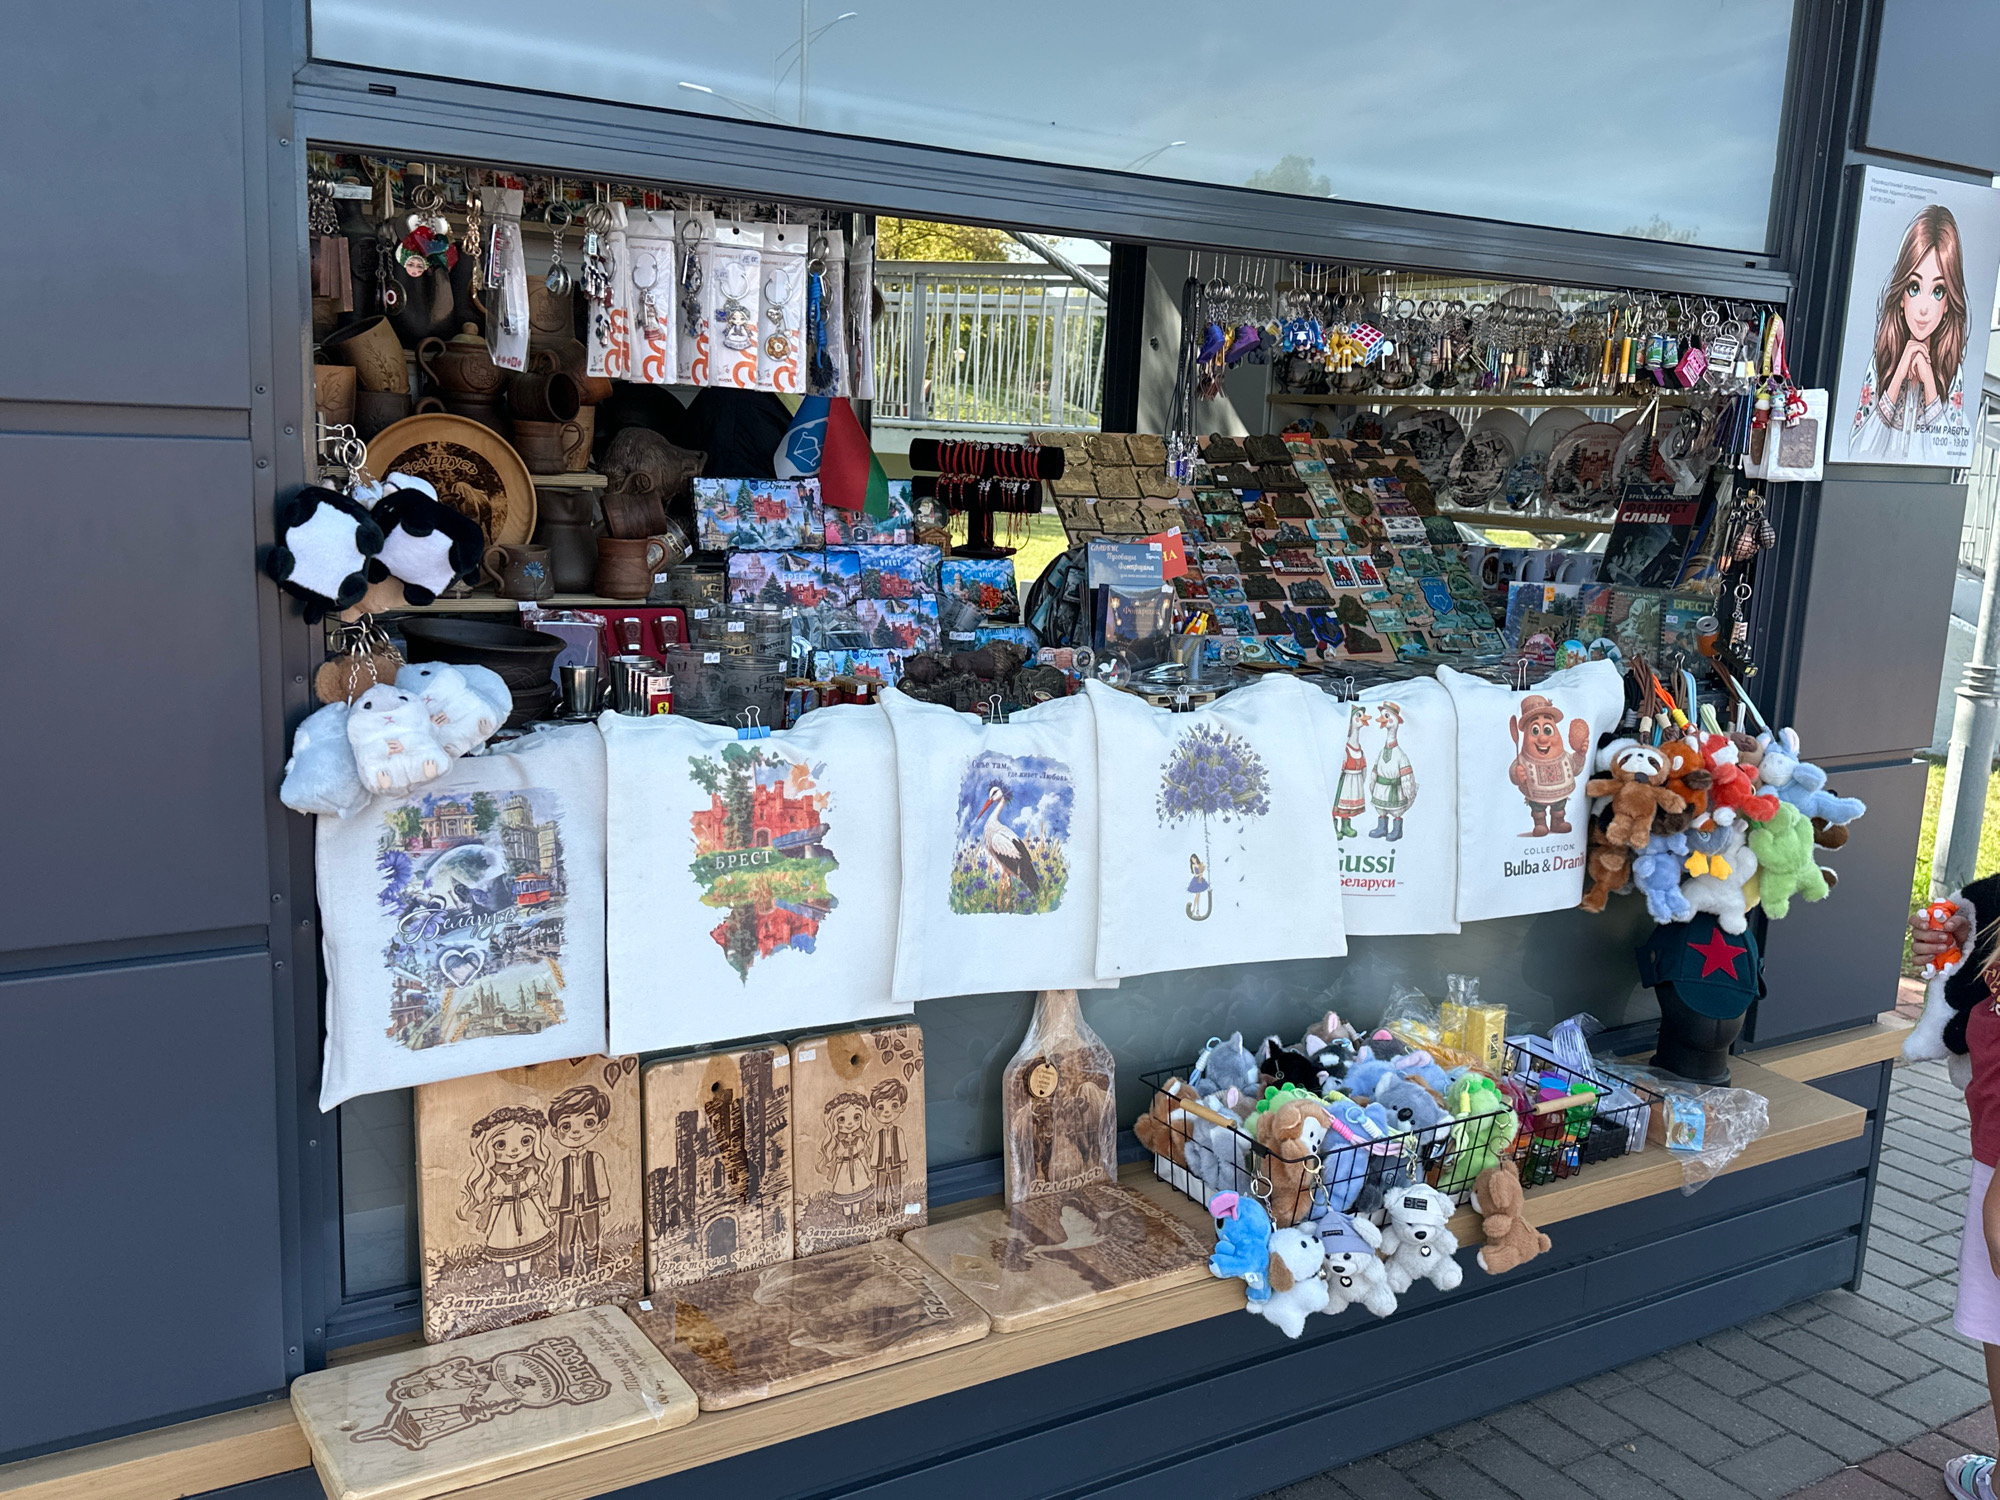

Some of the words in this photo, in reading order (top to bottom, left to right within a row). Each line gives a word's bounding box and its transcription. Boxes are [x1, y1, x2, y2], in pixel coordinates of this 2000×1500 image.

[1771, 319, 1779, 335] YOU
[1916, 424, 1941, 434] РЕЖИМ
[1943, 426, 1970, 436] РАБОТЫ
[1933, 437, 1948, 446] 10:00
[759, 480, 792, 492] Брест
[1625, 502, 1689, 514] ФОРПОСТ
[1621, 512, 1670, 523] СЛАВЫ
[782, 573, 810, 581] БРЕСТ
[1673, 599, 1711, 612] БРЕСТ
[727, 646, 751, 656] РЕСТ
[1040, 772, 1068, 781] Любовь
[1524, 844, 1575, 855] COLLECTION
[715, 851, 772, 870] БРЕСТ
[1504, 859, 1539, 877] Bulba
[1542, 858, 1551, 873] &
[398, 896, 517, 944] Беларусь
[1030, 1167, 1103, 1194] Беларусь
[807, 1226, 864, 1240] Запрашаем
[660, 1255, 727, 1272] Брестская
[731, 1231, 787, 1262] крепость
[443, 1289, 539, 1311] Запрашаем
[558, 1256, 632, 1293] Беларусь
[872, 1253, 954, 1319] Беларусь
[548, 1340, 594, 1381] БРЕСТ
[522, 1359, 553, 1399] ФОНАРЩИК
